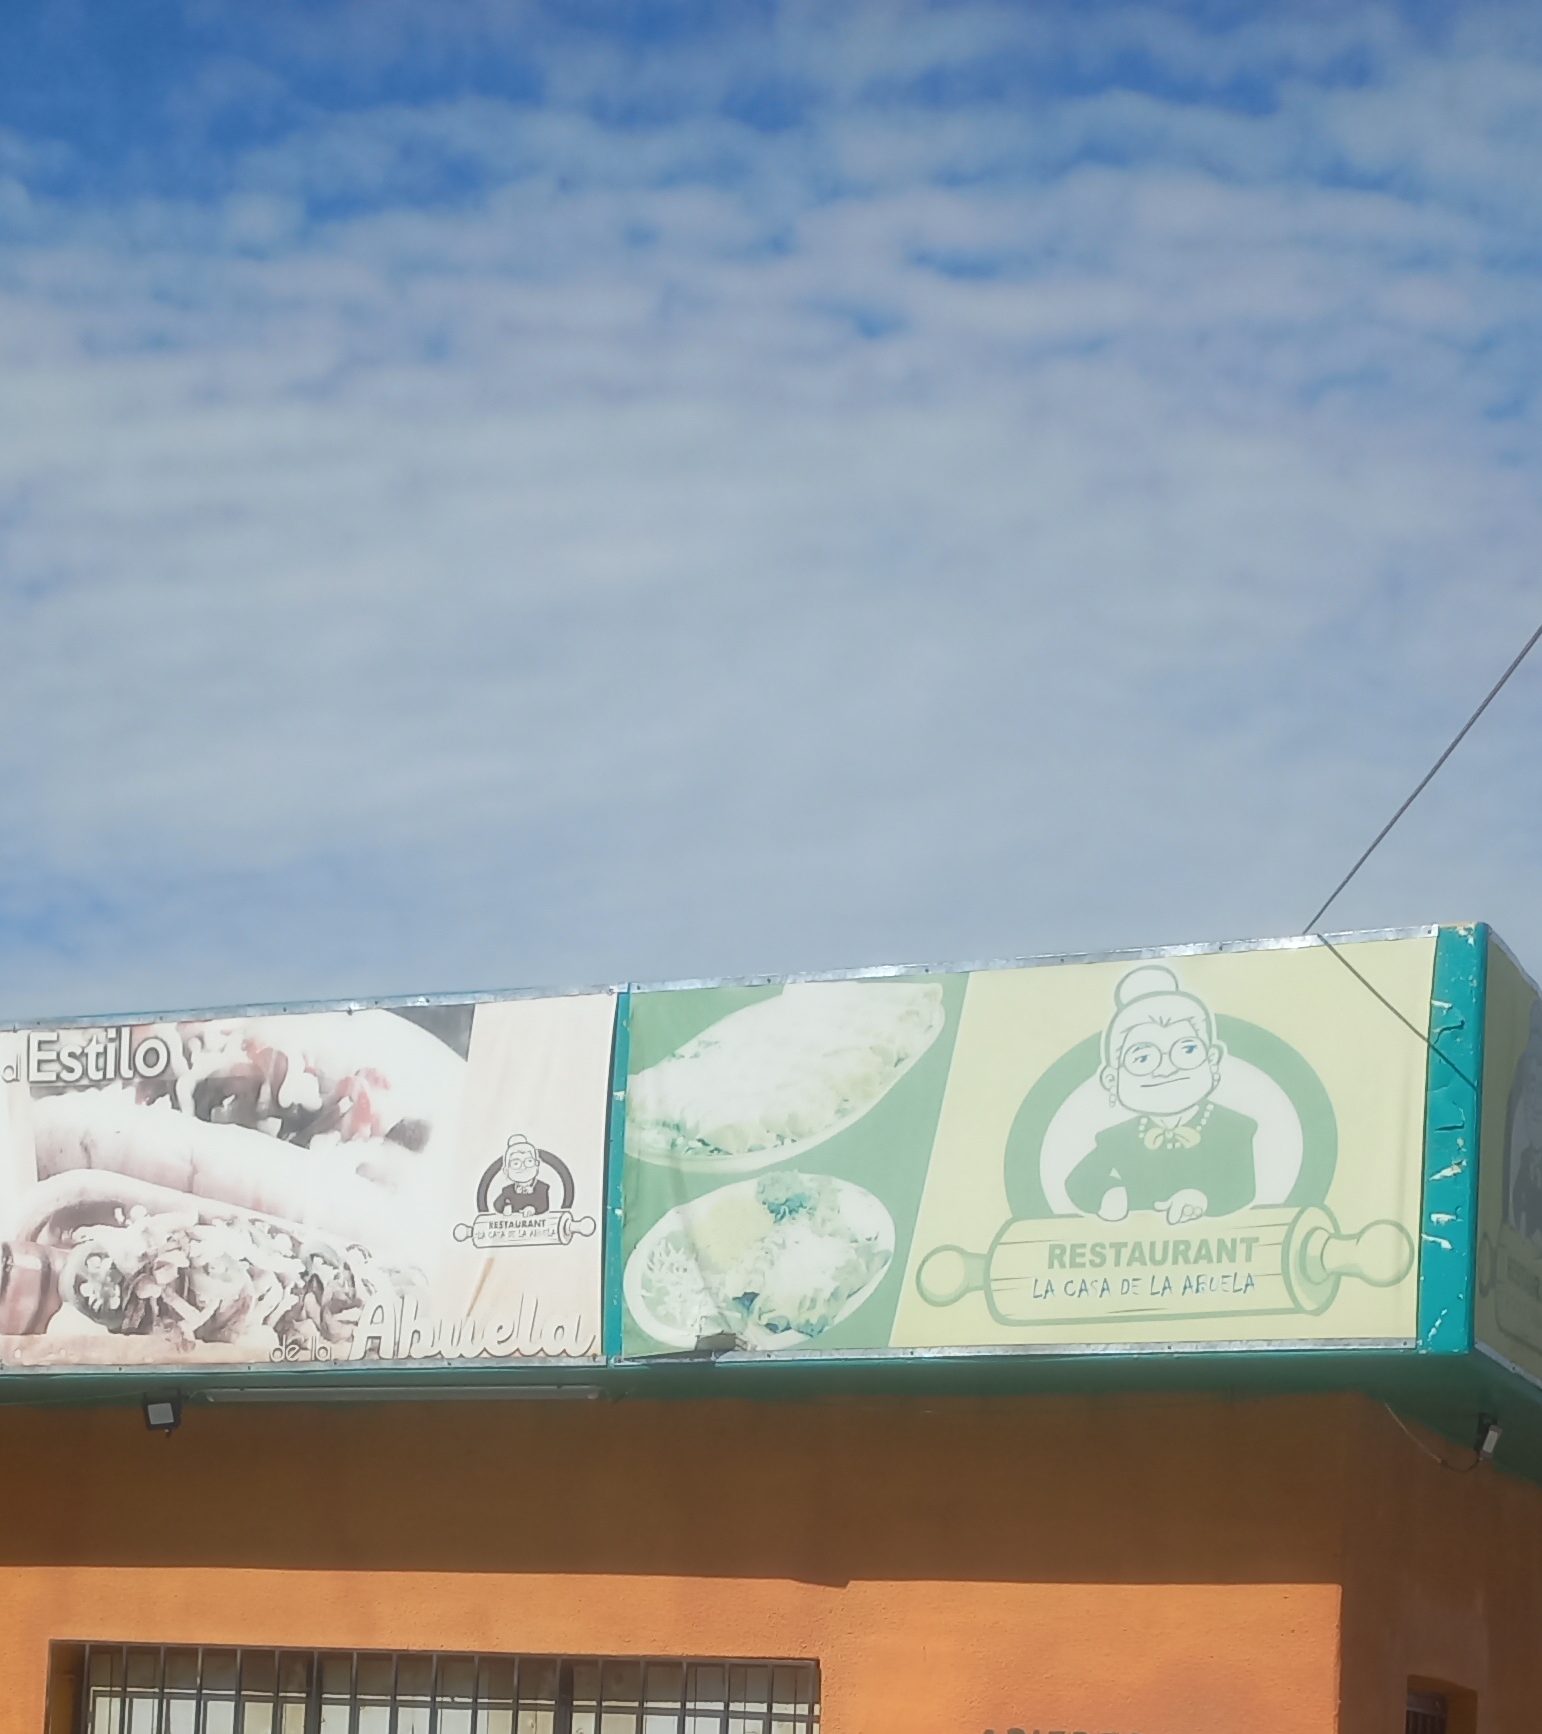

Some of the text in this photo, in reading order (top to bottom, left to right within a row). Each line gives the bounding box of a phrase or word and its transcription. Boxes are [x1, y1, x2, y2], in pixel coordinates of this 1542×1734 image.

[27, 1025, 171, 1083] Estilo
[488, 1219, 546, 1230] RESTAURANT
[1047, 1236, 1259, 1270] RESTAURANT
[1032, 1278, 1055, 1299] LA
[1064, 1277, 1111, 1298] CASA
[1120, 1278, 1142, 1296] DE
[1150, 1274, 1173, 1297] LA
